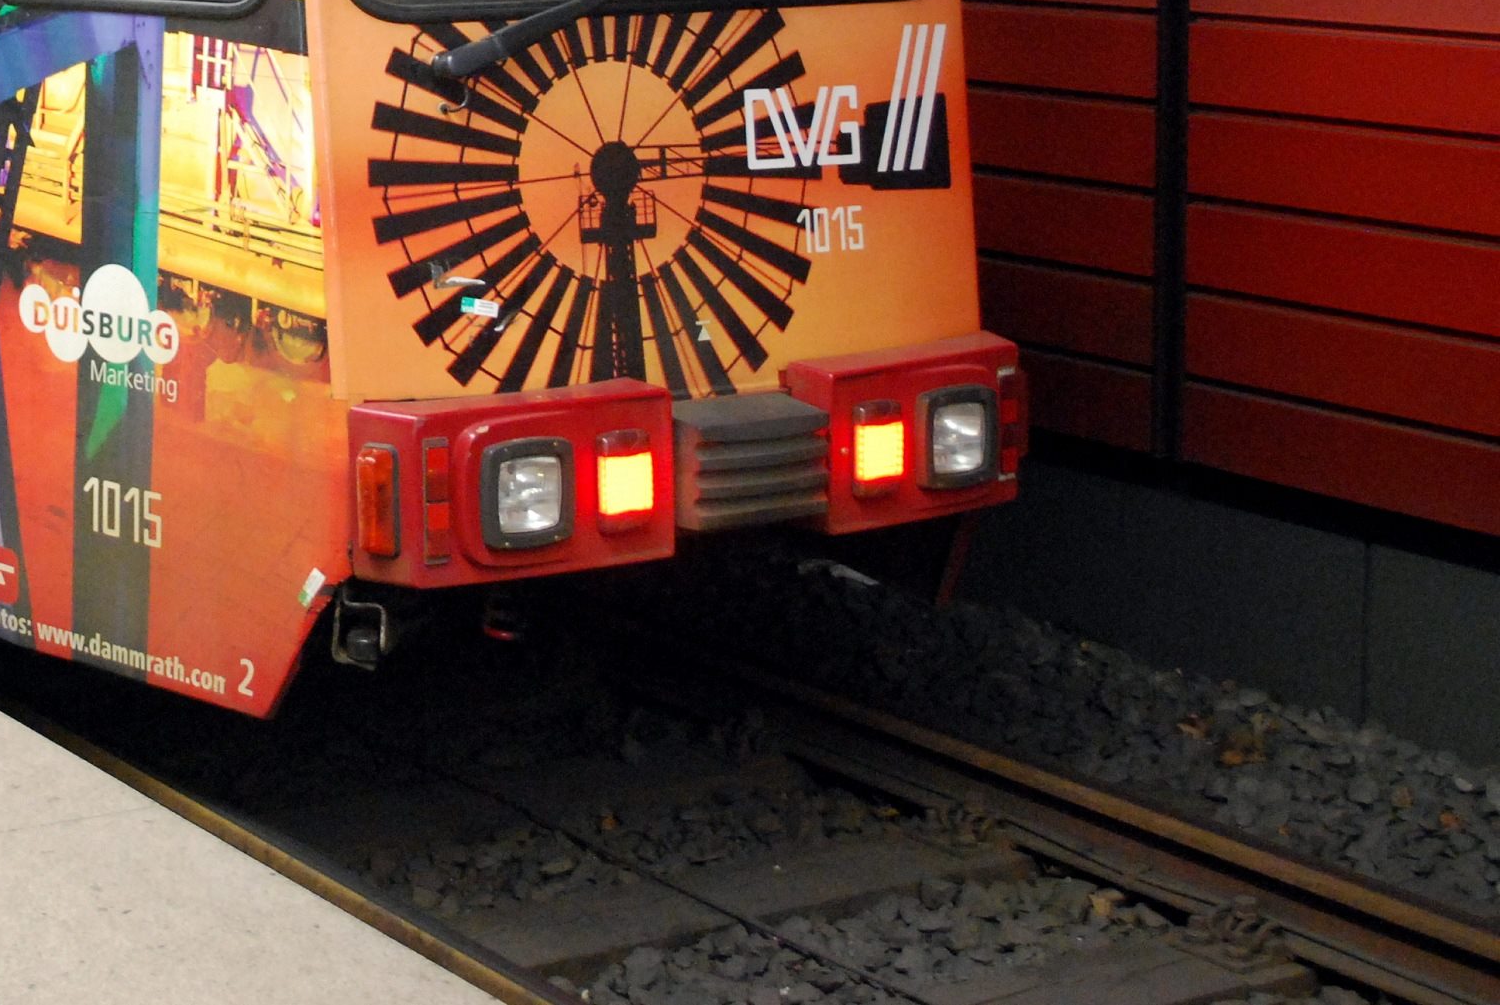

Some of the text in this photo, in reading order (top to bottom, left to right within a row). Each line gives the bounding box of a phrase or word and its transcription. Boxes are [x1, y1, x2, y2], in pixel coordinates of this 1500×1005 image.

[743, 85, 861, 170] DVG
[797, 205, 864, 253] 1015
[33, 300, 173, 350] DUISBURG
[90, 359, 178, 403] Marketing
[83, 476, 162, 549] 1015
[238, 658, 255, 697] 2
